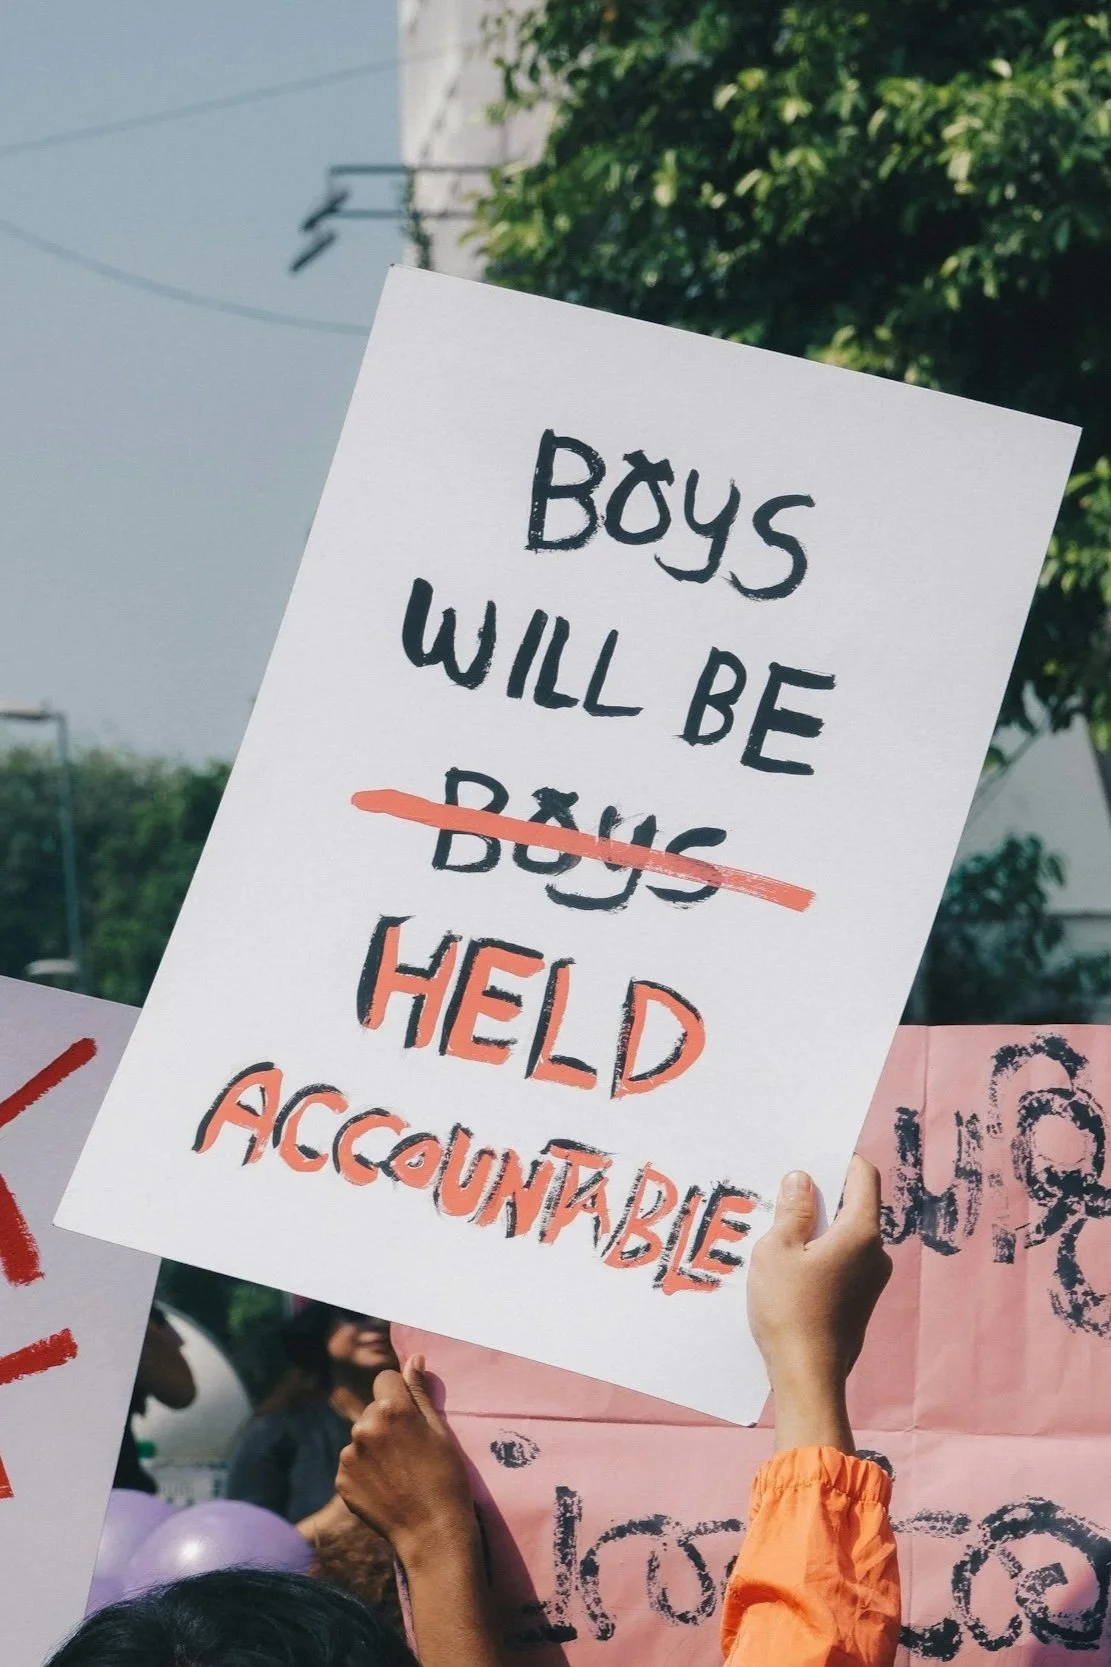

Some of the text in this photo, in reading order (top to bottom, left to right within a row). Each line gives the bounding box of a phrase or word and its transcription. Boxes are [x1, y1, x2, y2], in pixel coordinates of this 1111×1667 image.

[402, 578, 836, 775] WILL BE
[357, 914, 705, 1099] HELD
[192, 1061, 765, 1295] ACCOUNTABLE
